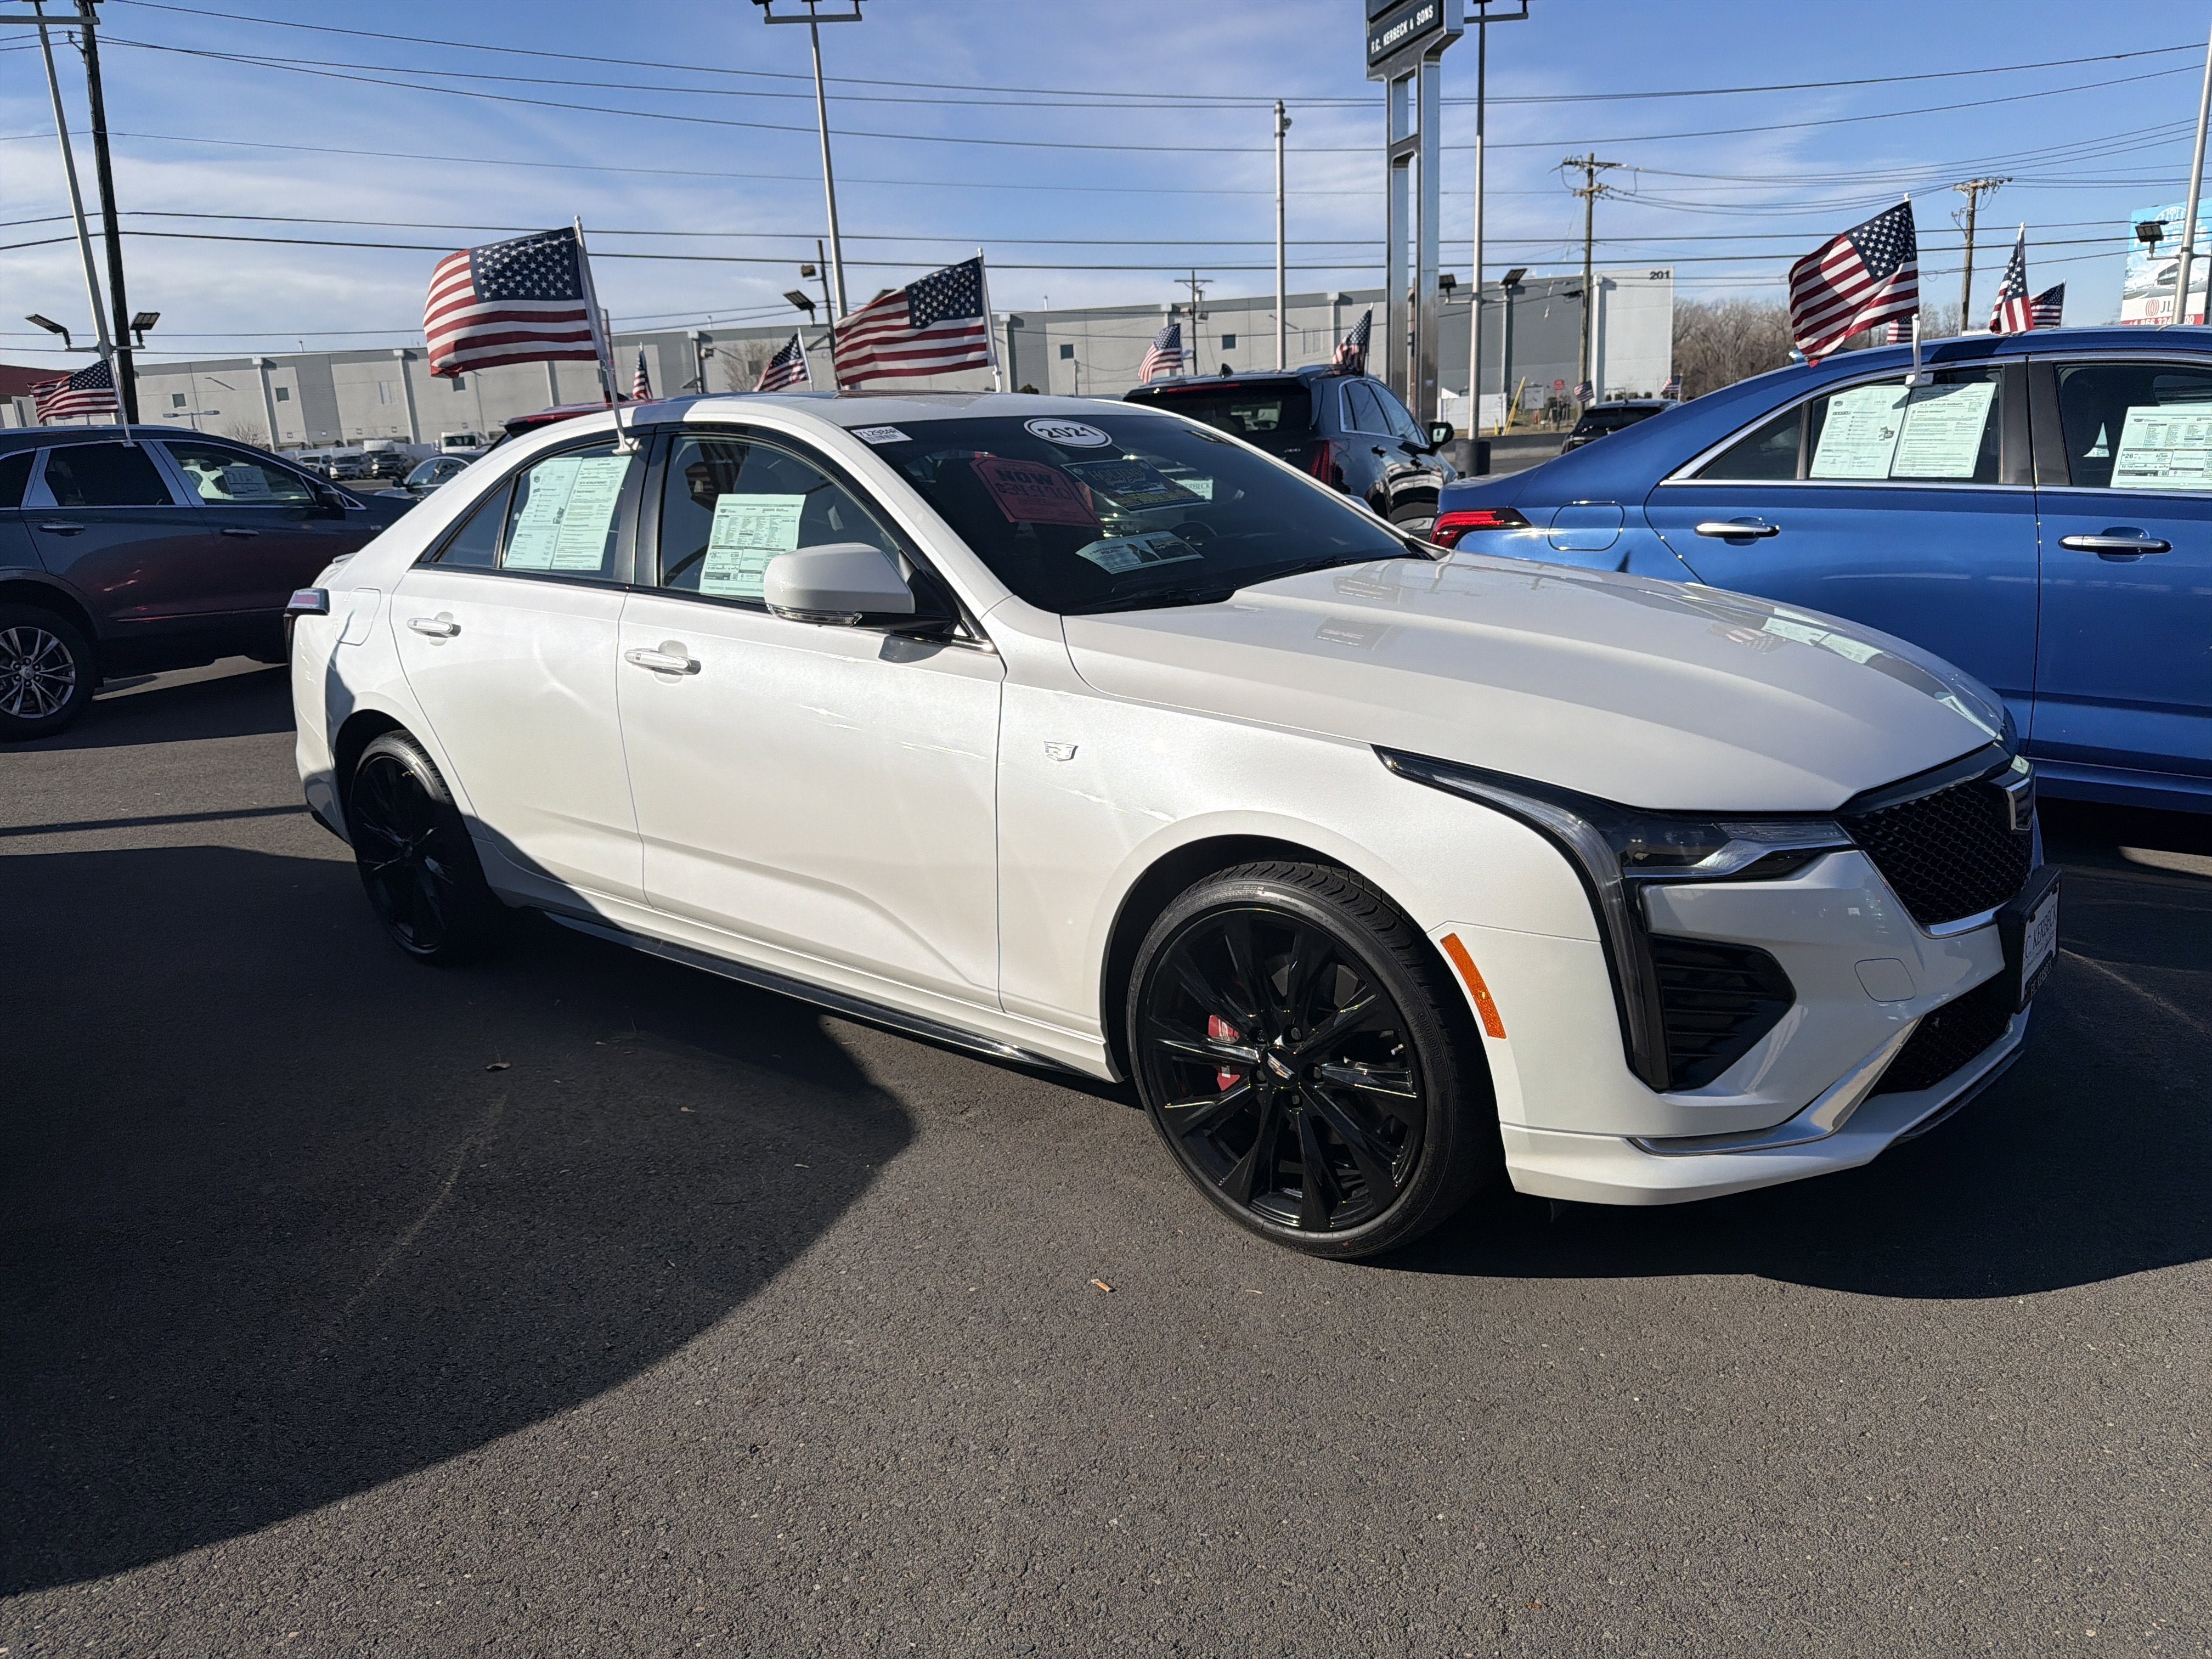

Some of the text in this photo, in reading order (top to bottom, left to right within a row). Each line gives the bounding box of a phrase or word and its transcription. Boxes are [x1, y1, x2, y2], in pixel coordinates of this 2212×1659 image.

[1383, 20, 1408, 47] KERBECK
[1417, 4, 1434, 26] SONS
[1650, 270, 1670, 280] 201
[1037, 426, 1099, 438] 2021
[995, 469, 1054, 486] NOW
[1087, 467, 1146, 481] HOLIDAY
